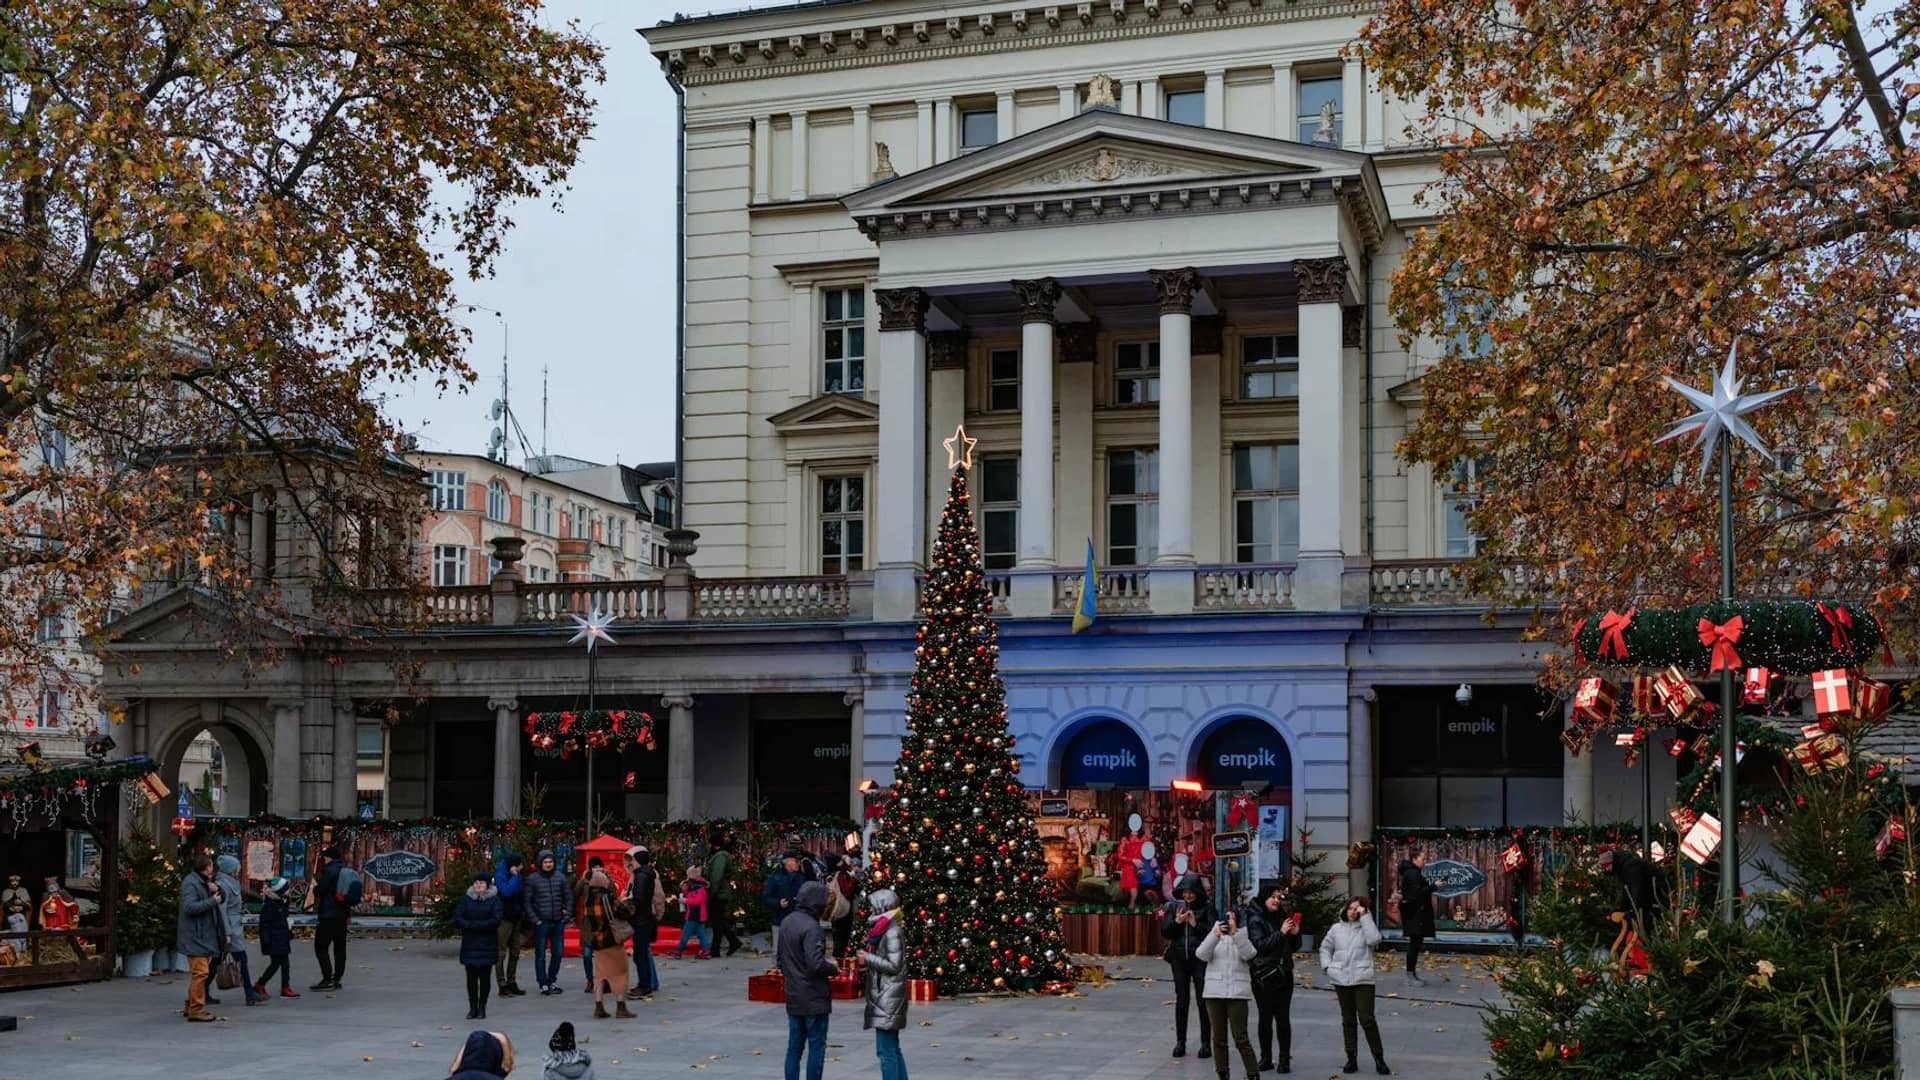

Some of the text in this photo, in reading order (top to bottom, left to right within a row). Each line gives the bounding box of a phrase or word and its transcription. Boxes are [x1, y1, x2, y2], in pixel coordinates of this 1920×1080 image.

[1448, 716, 1496, 735] empik
[1083, 748, 1137, 770] empik
[1219, 747, 1275, 769] empik
